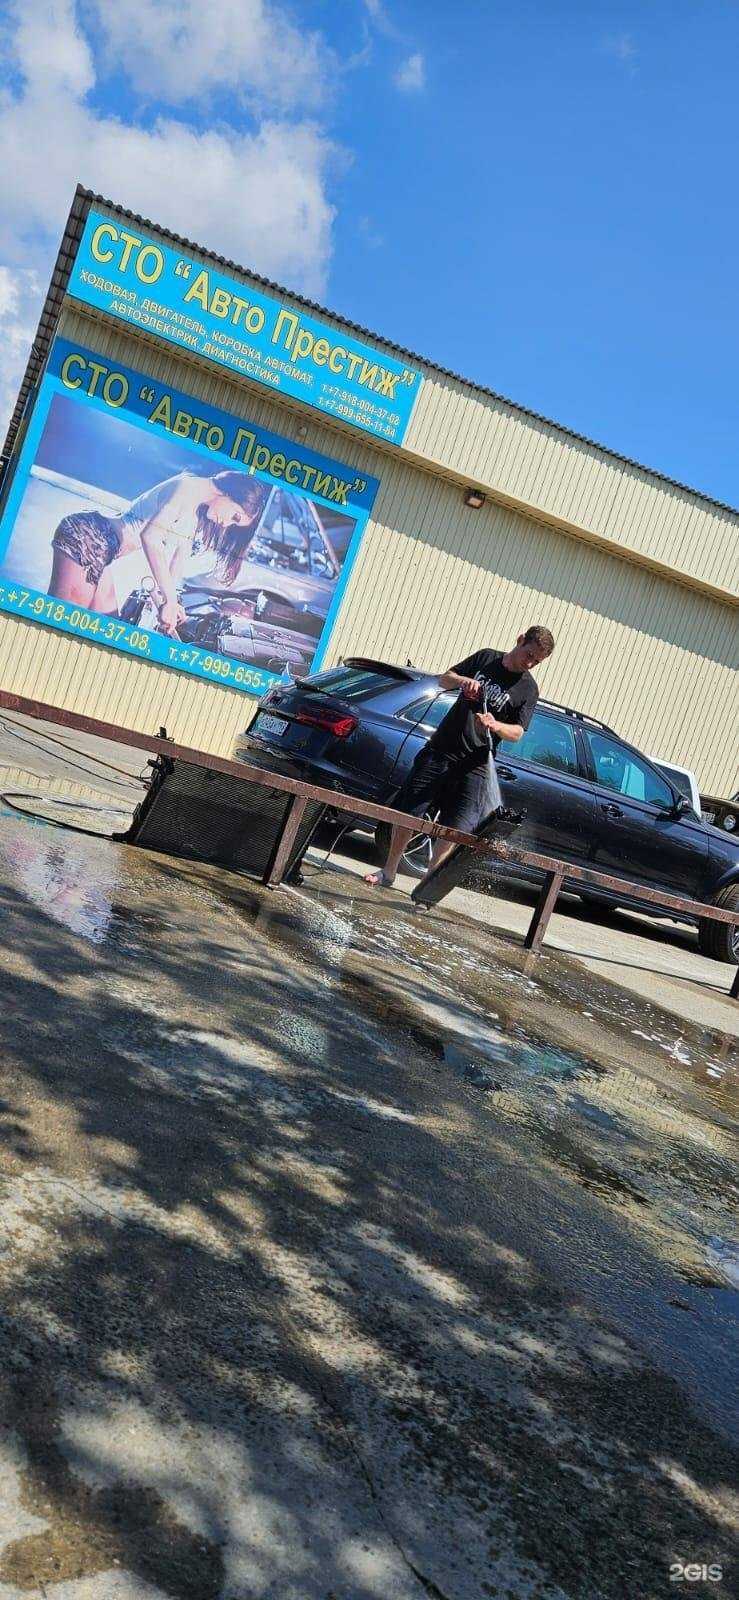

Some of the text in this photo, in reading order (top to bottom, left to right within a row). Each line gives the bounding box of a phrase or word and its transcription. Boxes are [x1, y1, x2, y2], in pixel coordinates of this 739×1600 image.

[91, 223, 165, 284] СТО
[80, 270, 138, 304] ХОДОВАЯ,
[141, 298, 208, 338] ДВИГАТЕЛЬ,
[211, 330, 261, 361] КОРОБКА
[61, 353, 129, 408] СТО
[201, 342, 281, 385] ДИАГНОСТИКА
